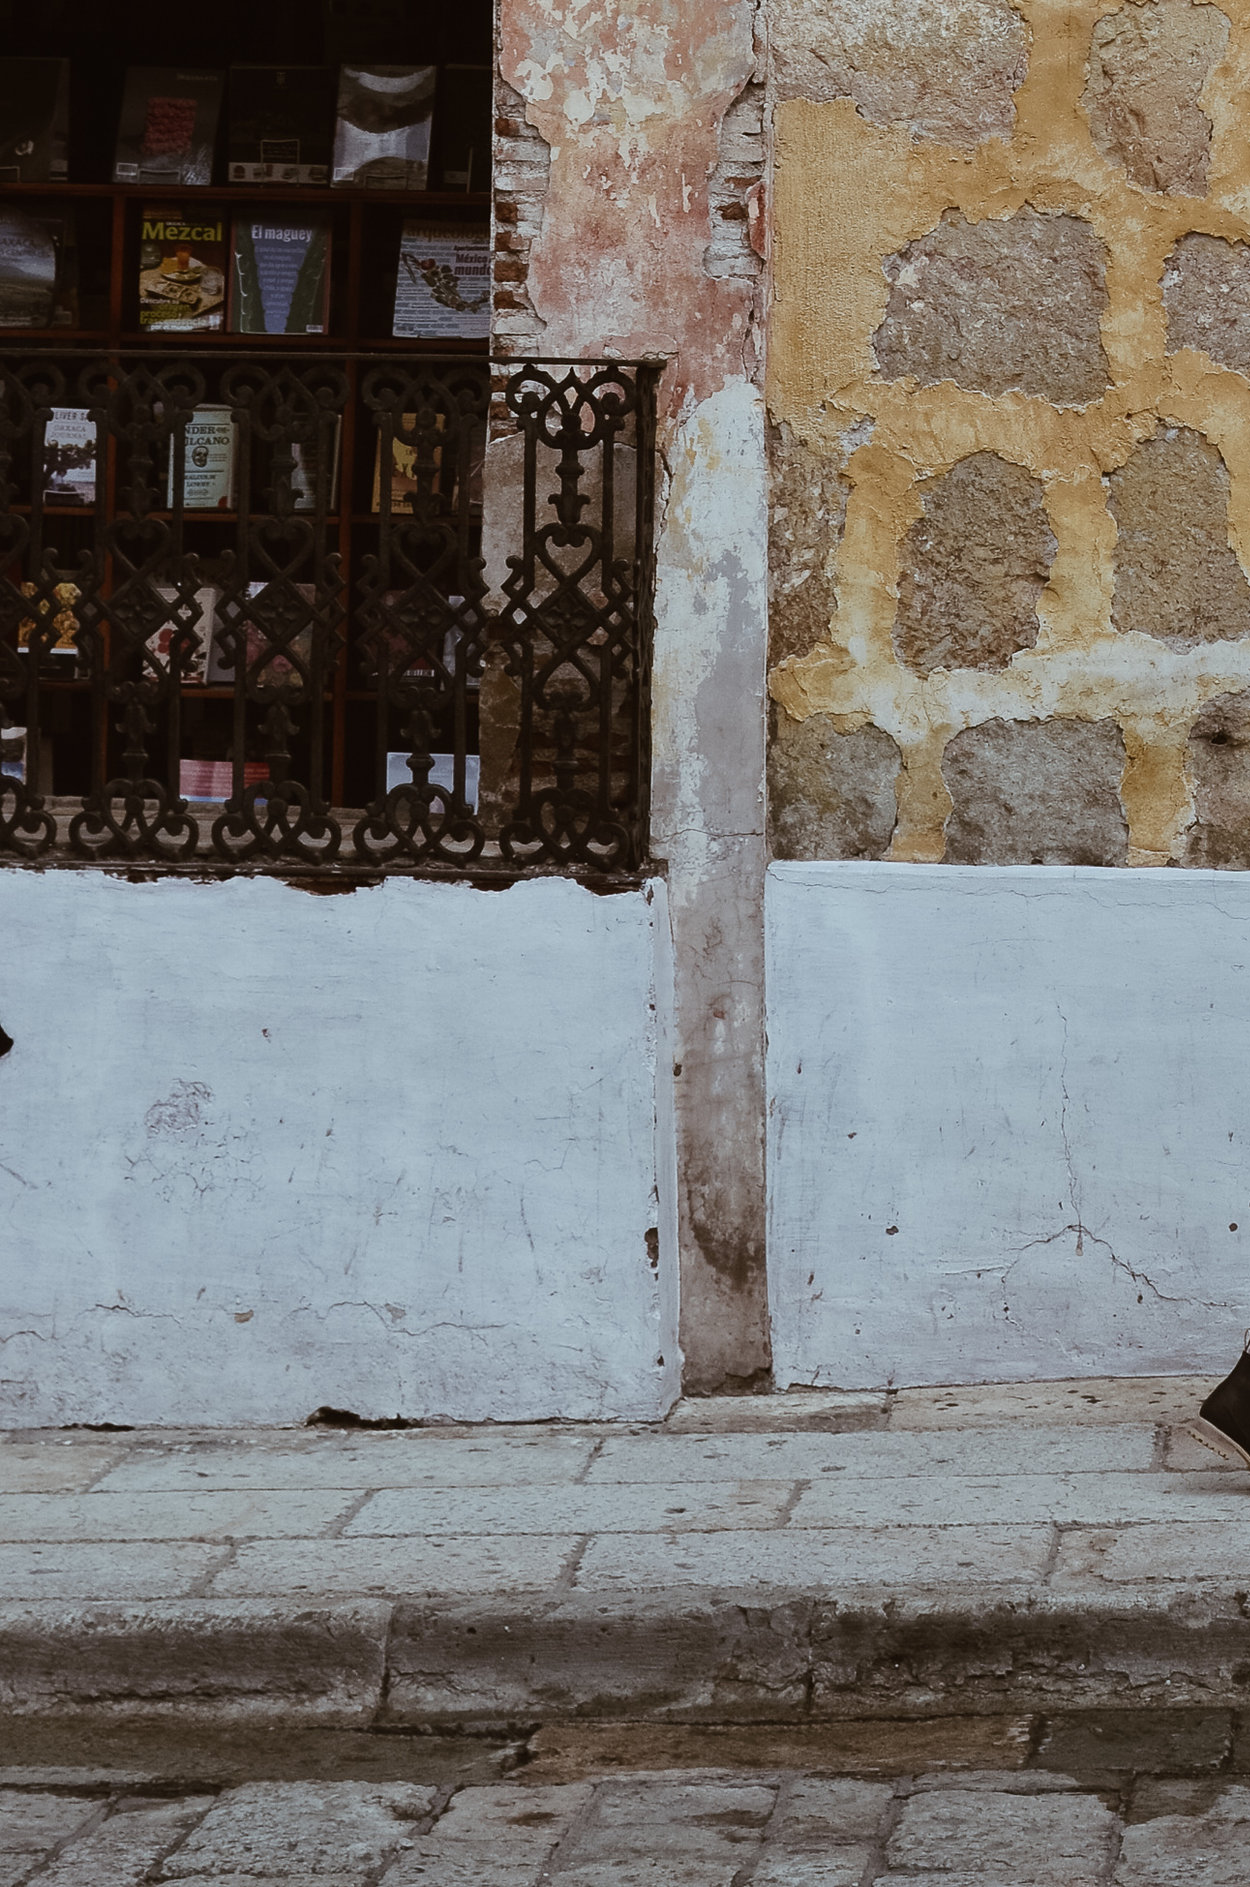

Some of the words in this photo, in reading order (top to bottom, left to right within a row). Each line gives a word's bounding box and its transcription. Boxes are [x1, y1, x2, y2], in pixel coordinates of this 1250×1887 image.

[141, 220, 222, 242] Mezcal
[250, 224, 262, 239] El
[265, 227, 313, 243] maguey
[455, 253, 488, 263] México
[55, 411, 78, 420] LIVER
[184, 426, 216, 434] NDER
